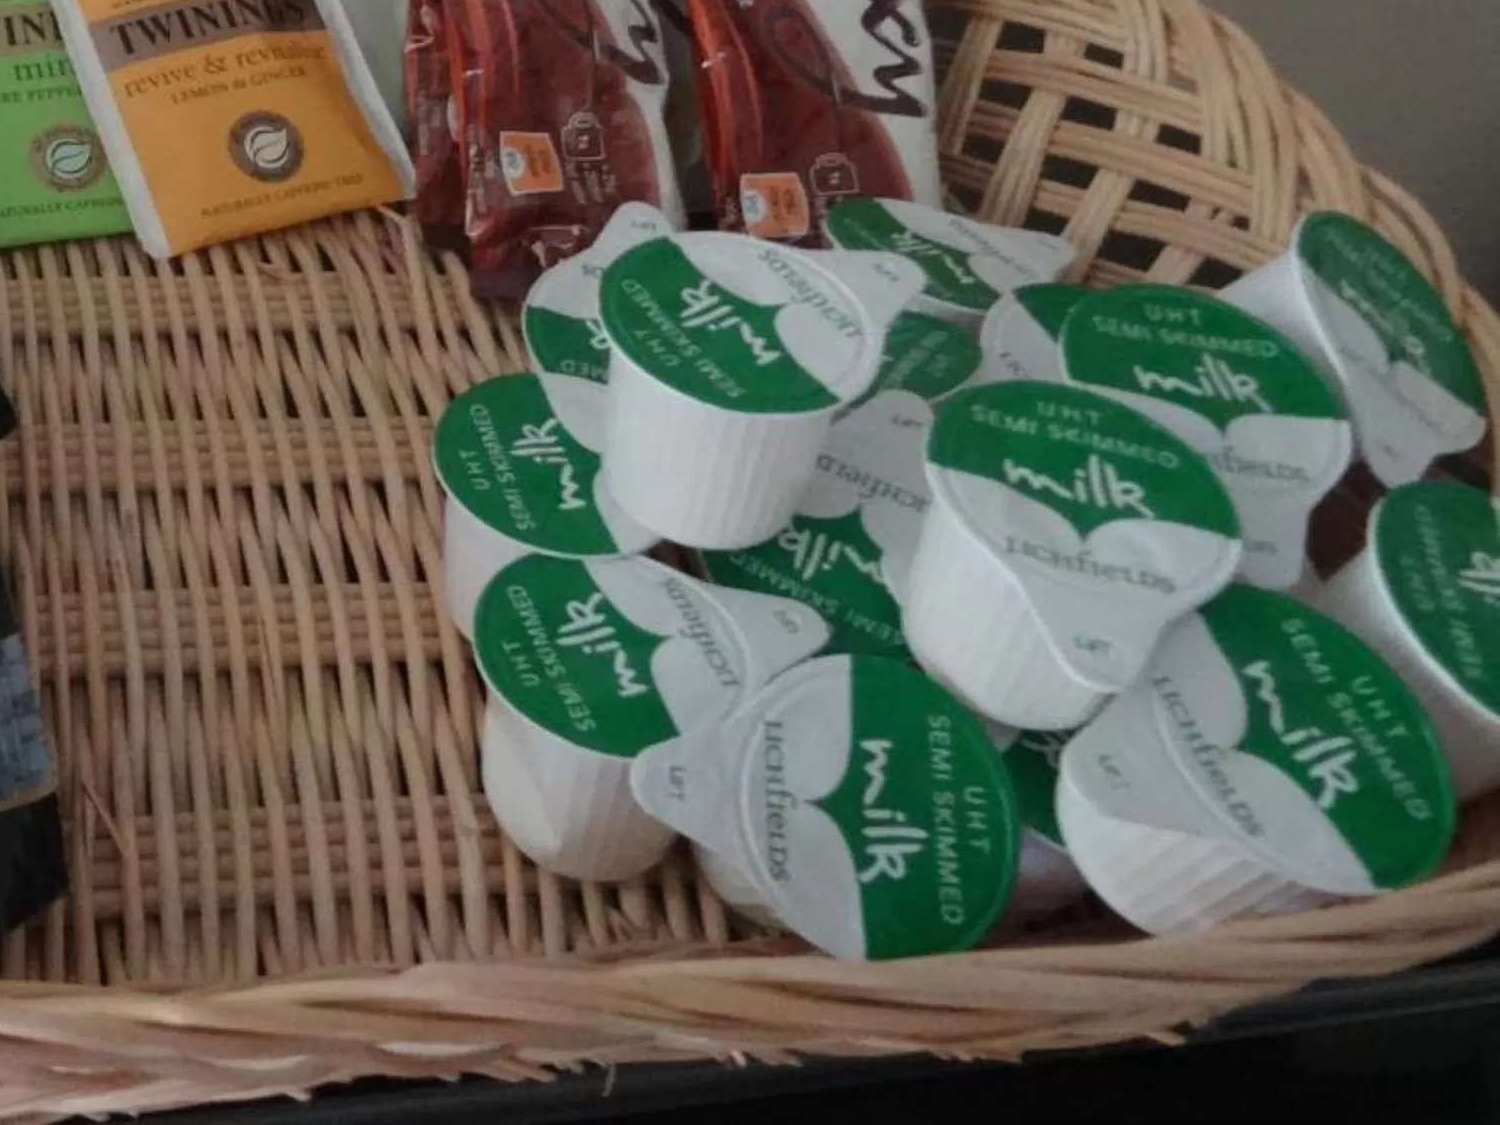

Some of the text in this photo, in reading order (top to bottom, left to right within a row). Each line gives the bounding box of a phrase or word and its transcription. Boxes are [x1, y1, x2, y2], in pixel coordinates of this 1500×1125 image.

[13, 58, 74, 81] min
[203, 54, 228, 76] &
[679, 279, 782, 367] milk
[1091, 313, 1280, 360] SEMI SKIMMED
[1143, 304, 1202, 326] UHT
[1036, 401, 1100, 425] UHT
[1132, 352, 1273, 414] milk
[458, 448, 492, 492] UHT
[469, 403, 537, 532] SEMI SKIMMED
[510, 417, 587, 511] milk
[971, 403, 1038, 437] SEMI
[1047, 423, 1180, 470] SKIMMED
[1003, 454, 1156, 520] milk
[501, 639, 540, 689] UHT
[505, 583, 596, 733] SEMI SKIMMED
[555, 591, 649, 699] milk
[1242, 659, 1360, 811] milk
[1280, 616, 1434, 822] SEMI SKIMMED
[1350, 675, 1411, 740] UHT
[858, 736, 930, 885] milk
[926, 714, 966, 926] SEMI SKIMMED
[961, 785, 991, 853] UHT
